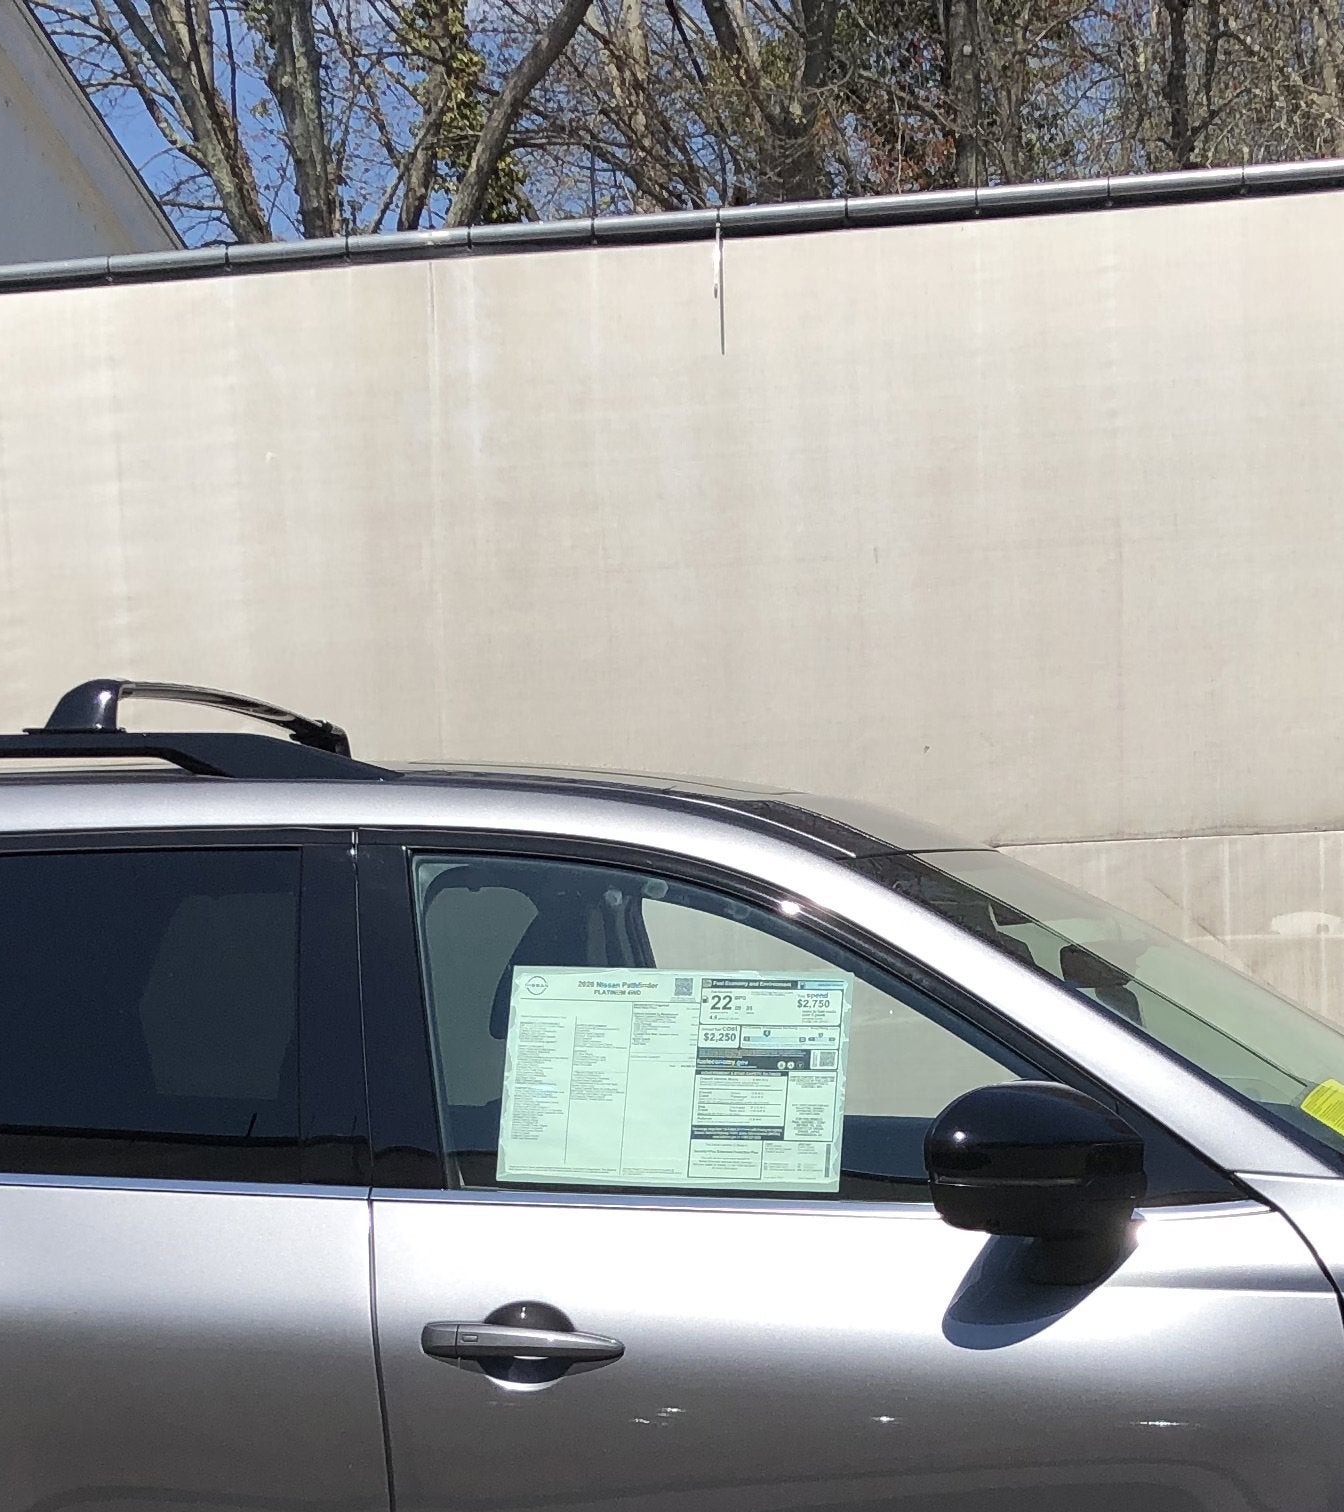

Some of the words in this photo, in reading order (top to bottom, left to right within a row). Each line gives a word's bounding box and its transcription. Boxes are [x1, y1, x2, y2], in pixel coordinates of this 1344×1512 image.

[710, 994, 733, 1010] 22
[796, 998, 830, 1009] $2,750
[703, 1032, 737, 1043] $2,250
